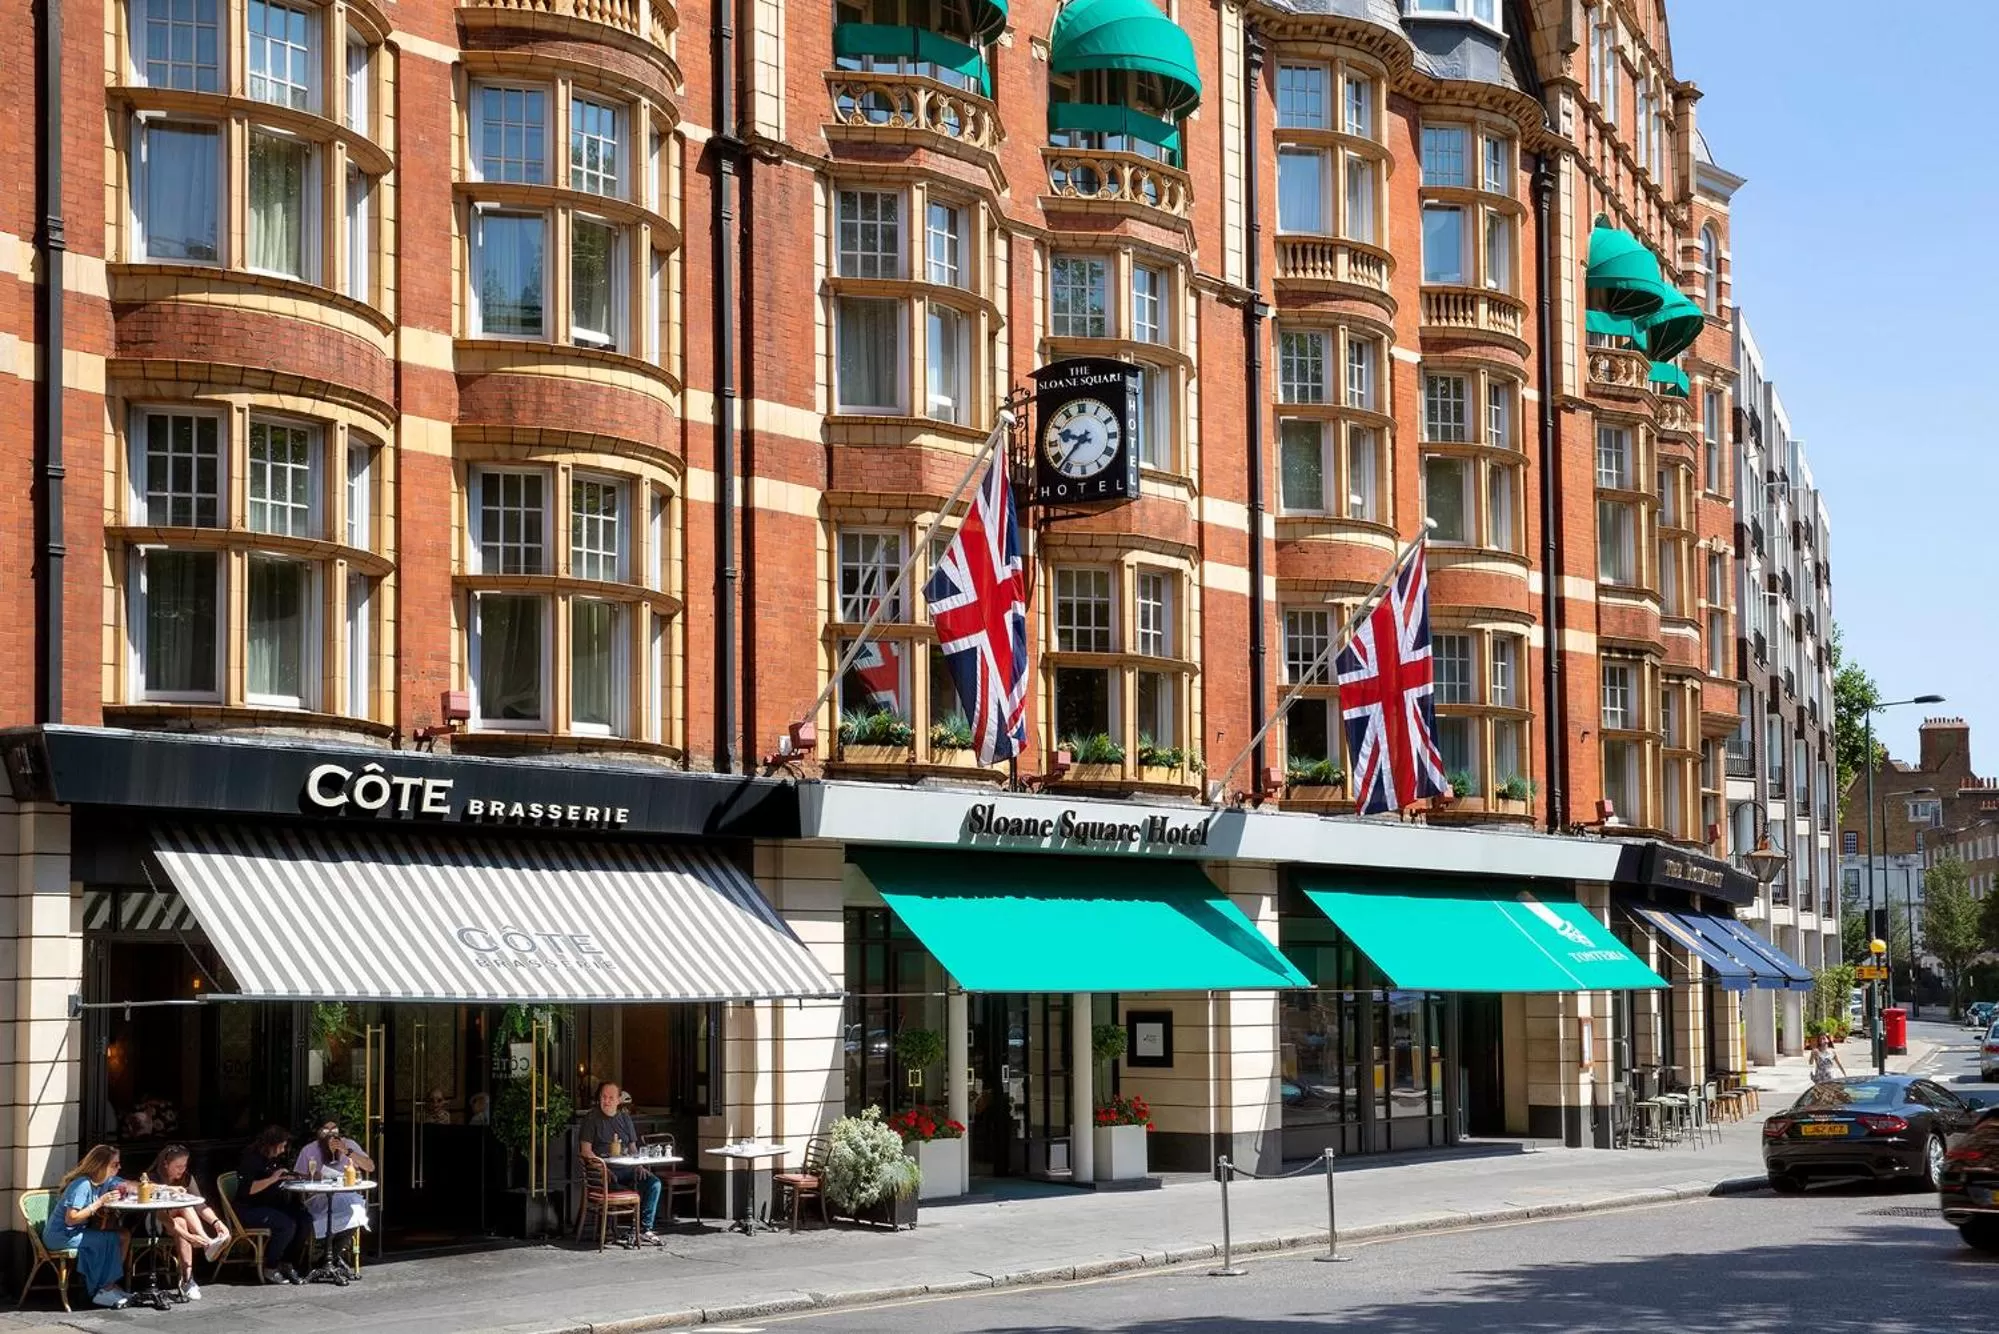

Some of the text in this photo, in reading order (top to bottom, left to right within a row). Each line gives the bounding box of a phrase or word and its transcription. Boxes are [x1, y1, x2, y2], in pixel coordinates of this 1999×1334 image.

[1039, 372, 1122, 390] SLOANE SQUARE
[1068, 366, 1090, 376] THE
[1128, 400, 1137, 486] HOTEL
[1041, 480, 1123, 497] HOTEL
[307, 762, 630, 823] CÔTE BRASSERIE
[968, 803, 1210, 846] Sloane Square Hotel
[456, 925, 604, 955] CÔTE
[475, 958, 617, 970] BRASSERIE
